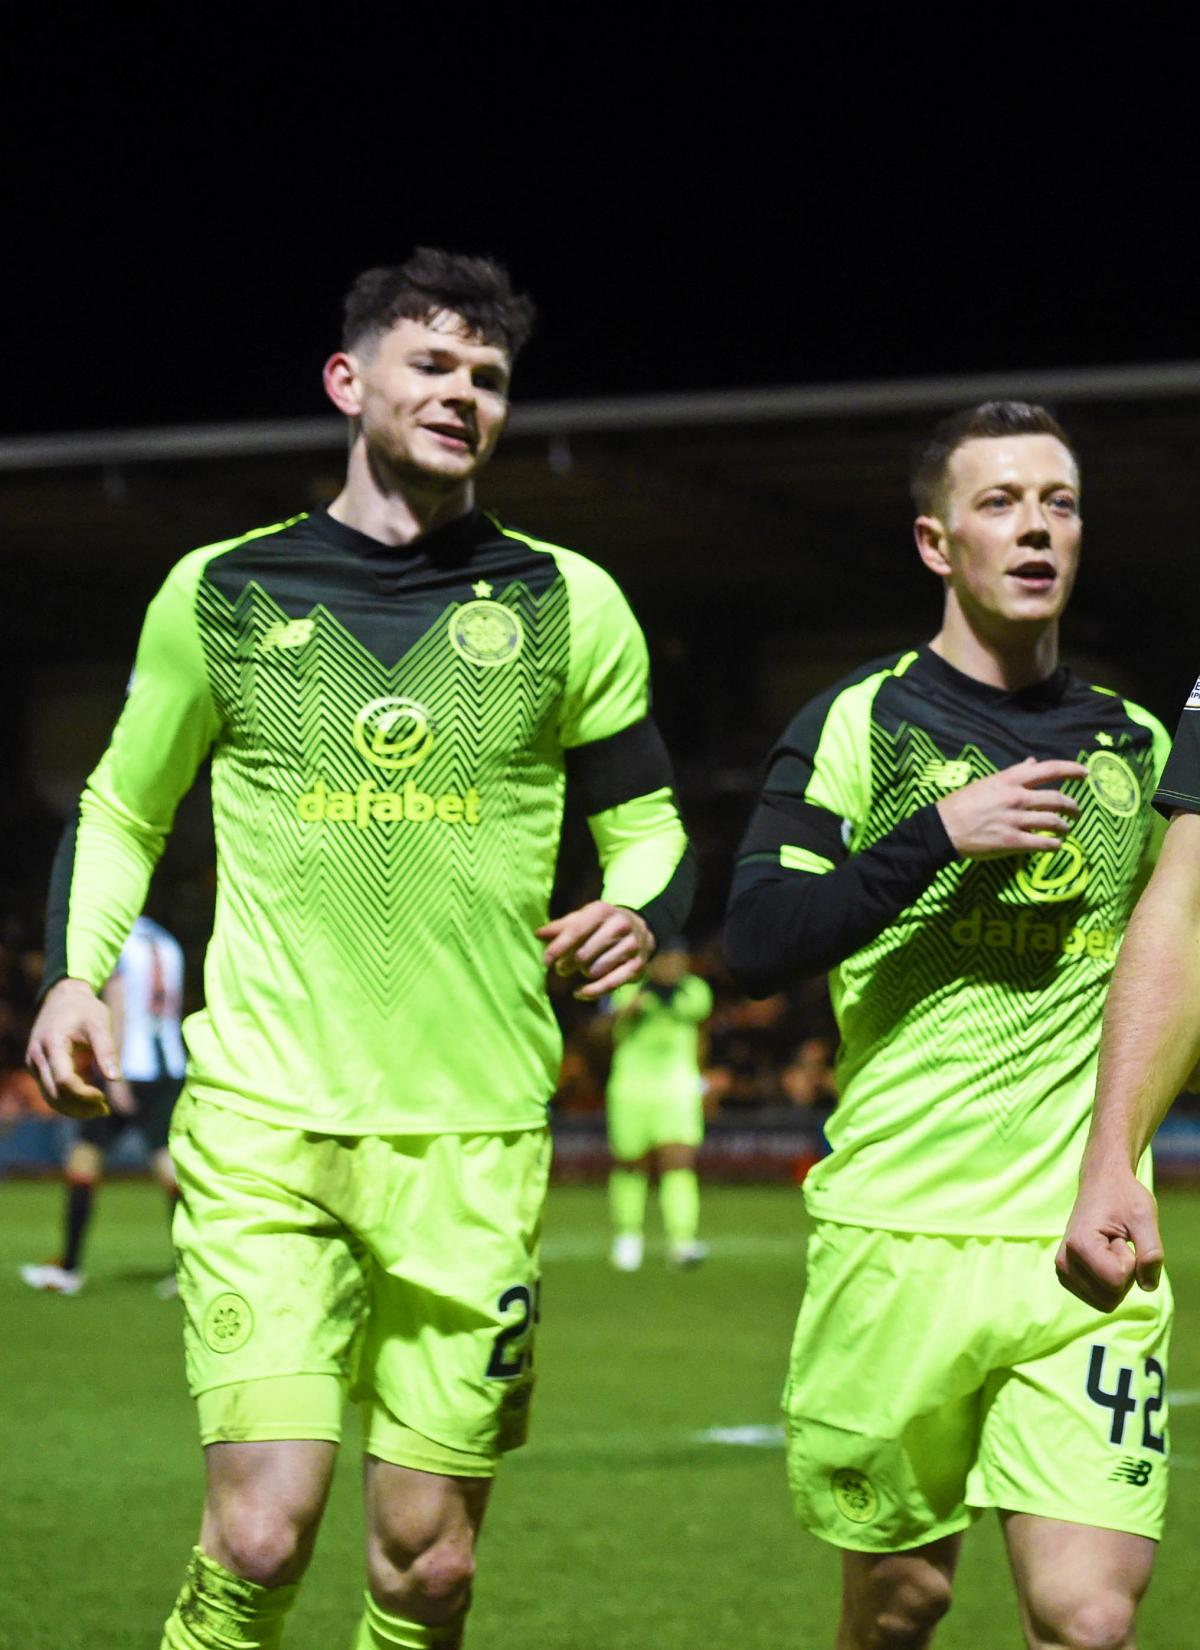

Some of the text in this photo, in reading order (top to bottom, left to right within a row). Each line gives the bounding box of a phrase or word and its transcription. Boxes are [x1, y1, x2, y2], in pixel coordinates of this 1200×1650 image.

[296, 778, 482, 830] dafabet
[484, 1279, 541, 1379] 2
[1086, 1343, 1166, 1455] 42
